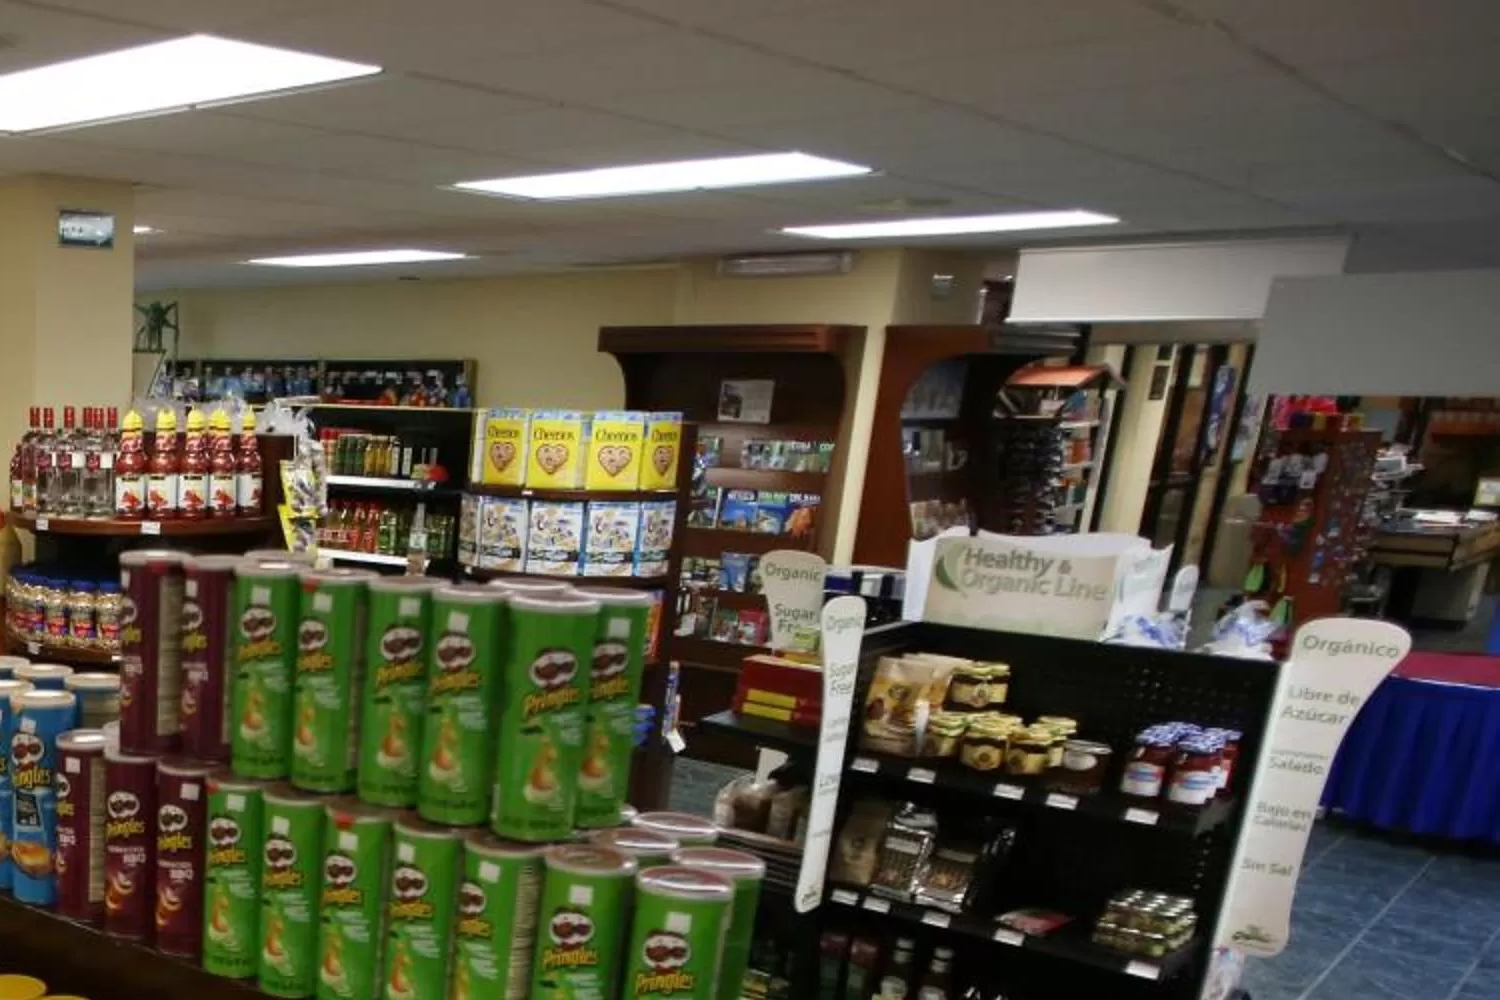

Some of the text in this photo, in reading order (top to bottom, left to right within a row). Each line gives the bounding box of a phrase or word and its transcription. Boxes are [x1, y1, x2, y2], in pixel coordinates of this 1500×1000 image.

[964, 546, 1053, 577] Healthy
[765, 563, 821, 580] Organic
[961, 568, 1108, 601] Organic Line
[775, 603, 815, 620] Sugar
[1288, 686, 1361, 705] Libre de
